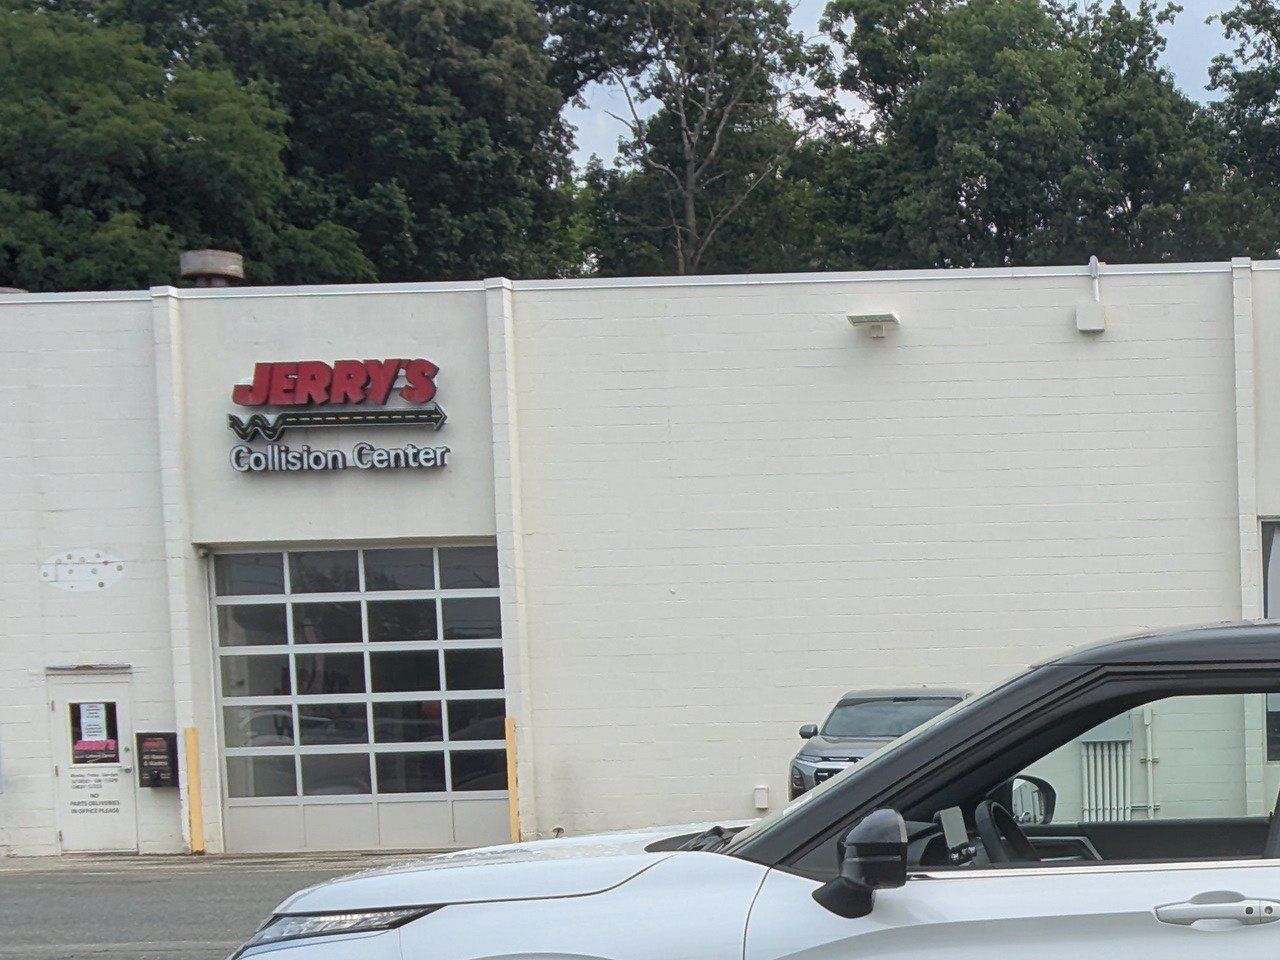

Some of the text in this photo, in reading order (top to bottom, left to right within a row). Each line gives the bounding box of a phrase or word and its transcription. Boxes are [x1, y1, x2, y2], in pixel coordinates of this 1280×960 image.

[232, 358, 440, 406] JERRY'S
[229, 442, 450, 472] Collision Center
